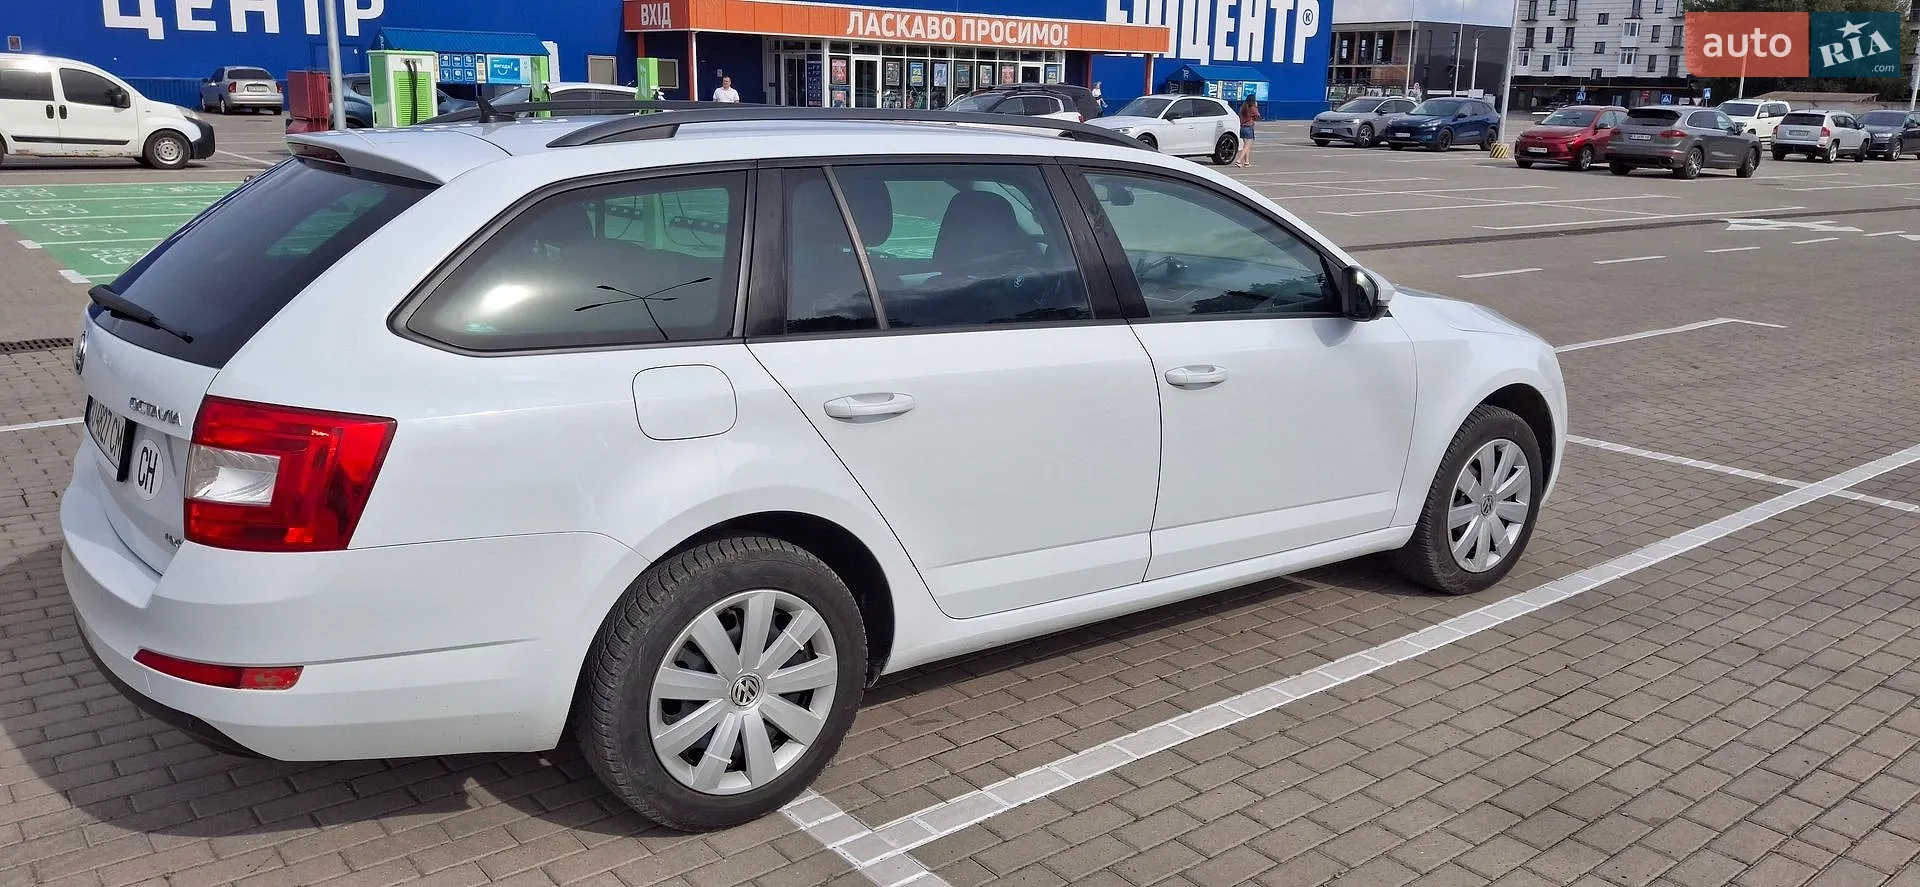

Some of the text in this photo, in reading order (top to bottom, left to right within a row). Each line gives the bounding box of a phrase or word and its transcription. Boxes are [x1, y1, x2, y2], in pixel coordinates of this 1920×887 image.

[641, 2, 672, 29] ВХІД
[846, 11, 1069, 46] ЛАСКАВО ПРОСИМО!
[129, 396, 182, 427] OCTAVIA
[138, 446, 158, 494] CH
